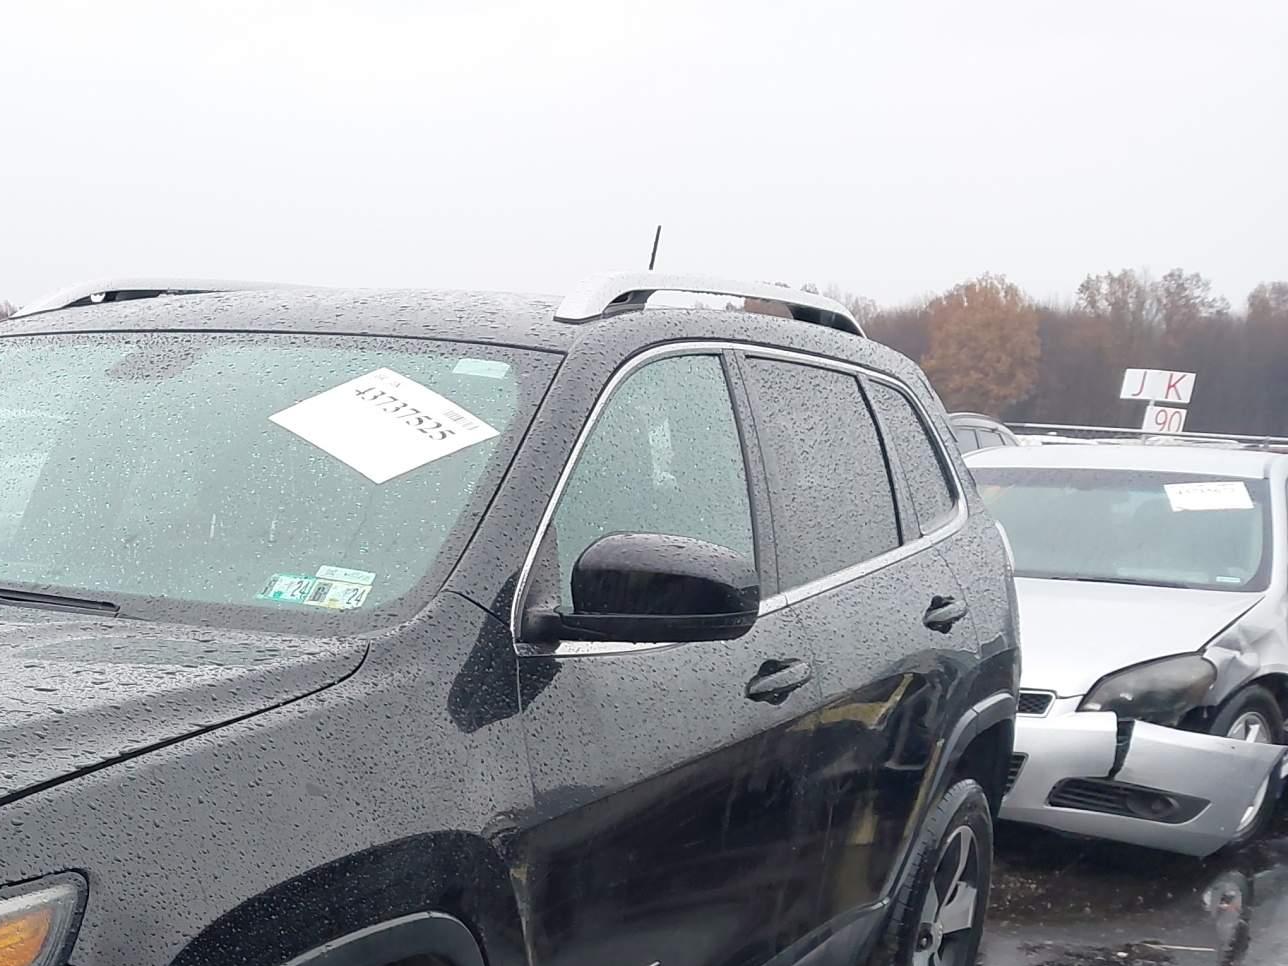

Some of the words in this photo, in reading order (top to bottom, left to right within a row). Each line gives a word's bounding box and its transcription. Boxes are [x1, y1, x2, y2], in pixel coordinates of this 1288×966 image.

[1131, 371, 1148, 397] J
[1165, 373, 1187, 400] K
[354, 386, 457, 441] 43737525
[1155, 409, 1183, 433] 90
[345, 588, 367, 605] 24
